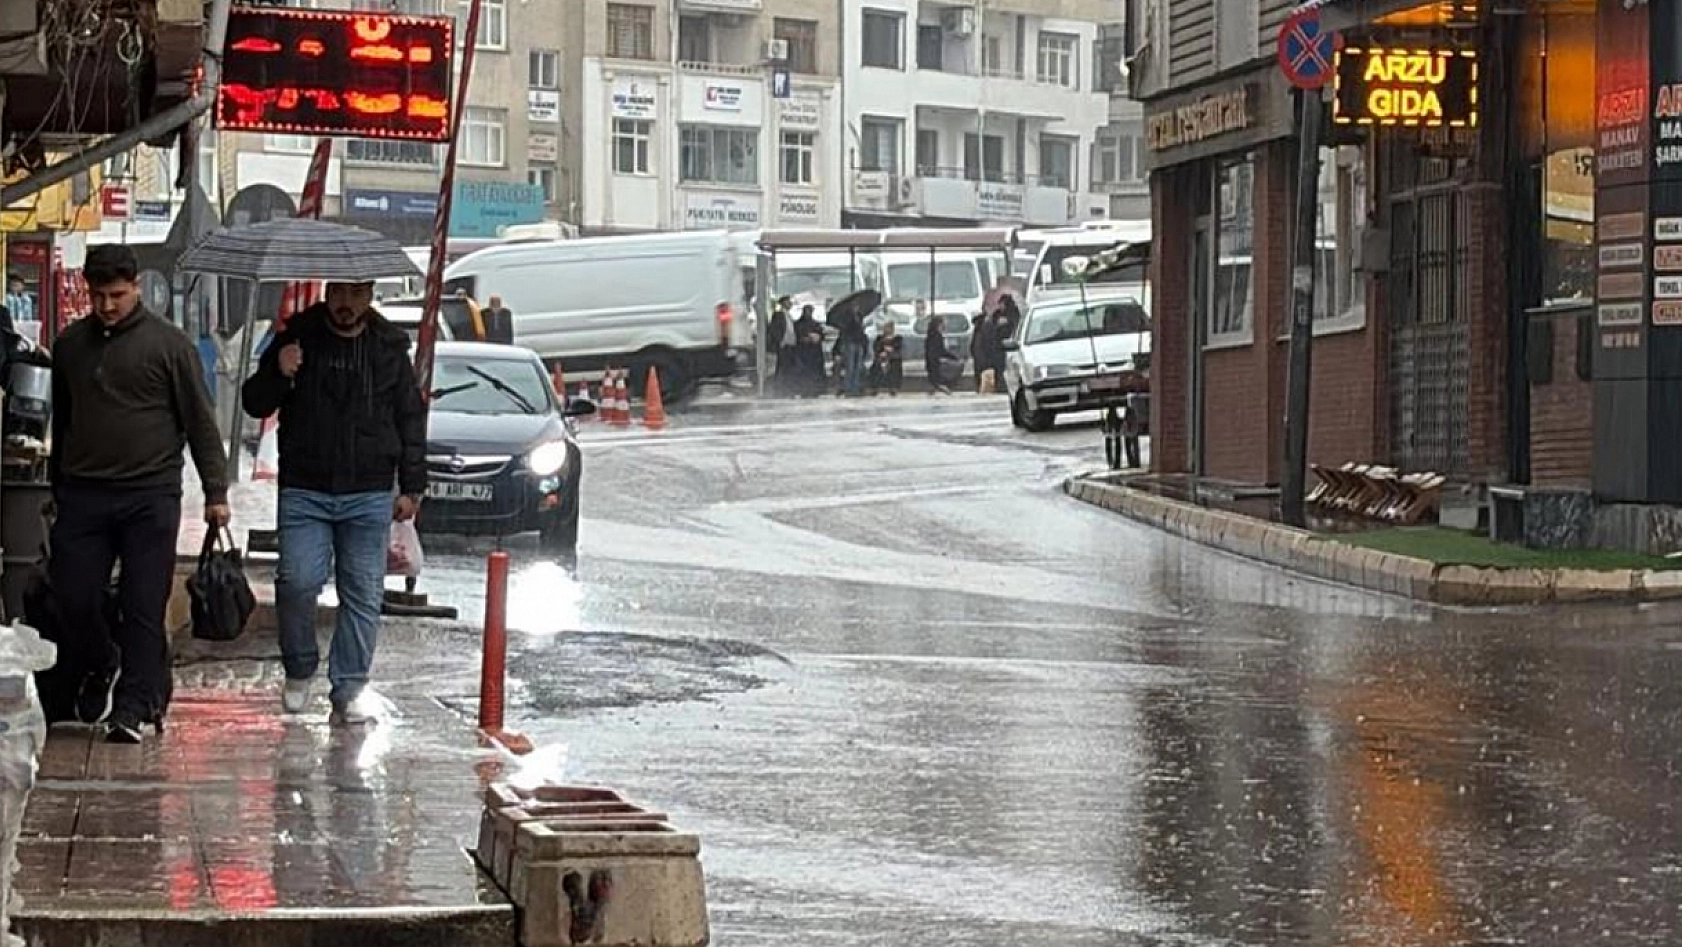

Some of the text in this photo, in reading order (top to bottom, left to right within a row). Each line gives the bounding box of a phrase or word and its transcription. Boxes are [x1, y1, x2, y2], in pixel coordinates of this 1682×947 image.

[1363, 54, 1446, 84] ARZU
[1367, 88, 1443, 117] GIDA
[1598, 88, 1644, 129] ARZU
[1601, 123, 1639, 147] MANAV
